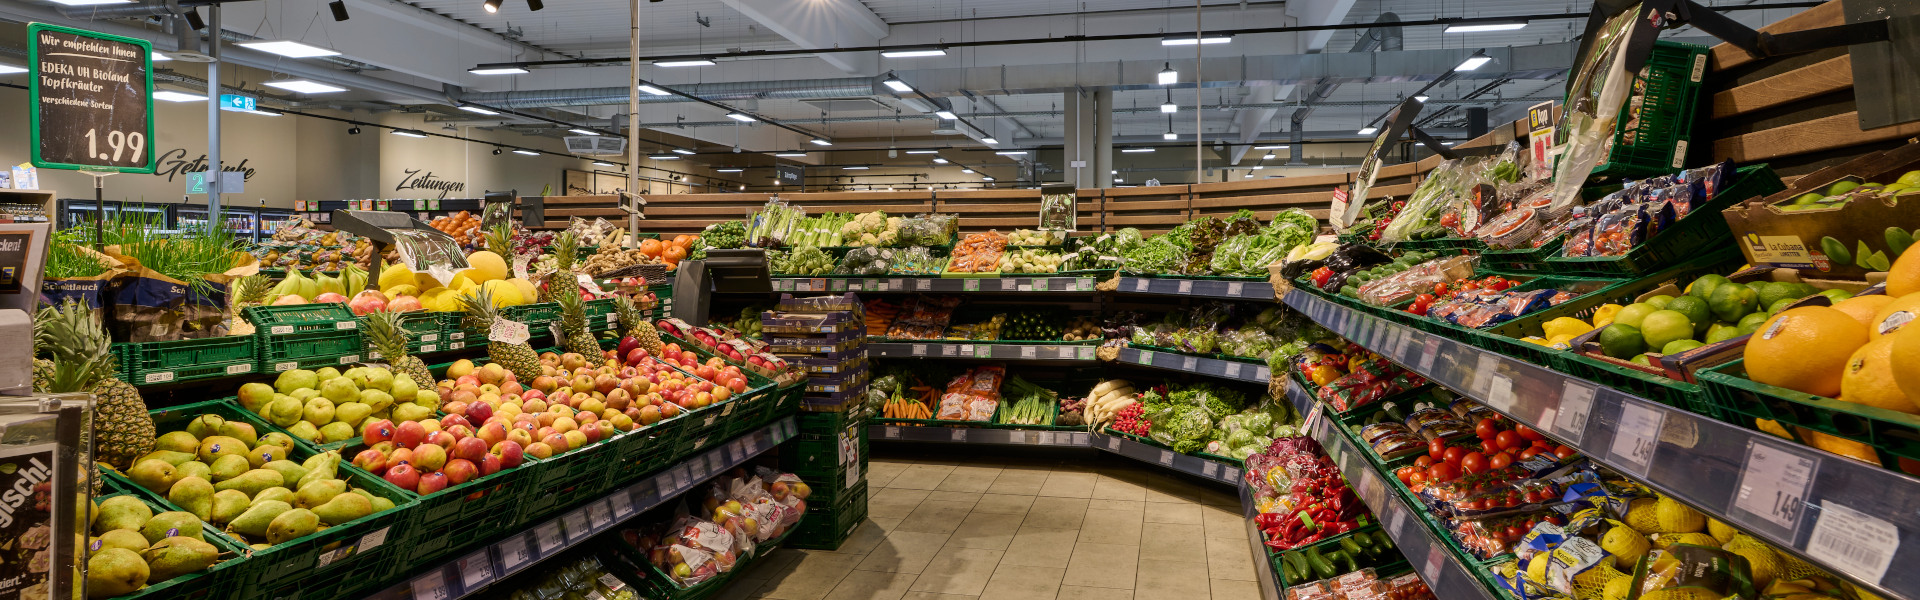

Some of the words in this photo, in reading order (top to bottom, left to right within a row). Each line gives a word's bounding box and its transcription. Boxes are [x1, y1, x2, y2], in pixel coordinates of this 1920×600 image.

[41, 34, 60, 46] Wir
[63, 40, 110, 55] empfehlen
[112, 46, 137, 59] Ihnen
[41, 61, 75, 76] EDEKA
[77, 66, 91, 79] UH
[93, 69, 130, 83] Bioland
[41, 75, 104, 93] Topfkräuter
[42, 96, 89, 108] verschiedene
[90, 101, 113, 110] Sorten
[85, 128, 144, 163] 1.99
[192, 173, 203, 192] 2
[396, 167, 466, 200] Zeitungen
[1779, 243, 1804, 251] Cubana
[44, 282, 98, 291] Schnittlauch
[1632, 437, 1652, 460] 2.49
[1772, 490, 1800, 522] 1.49
